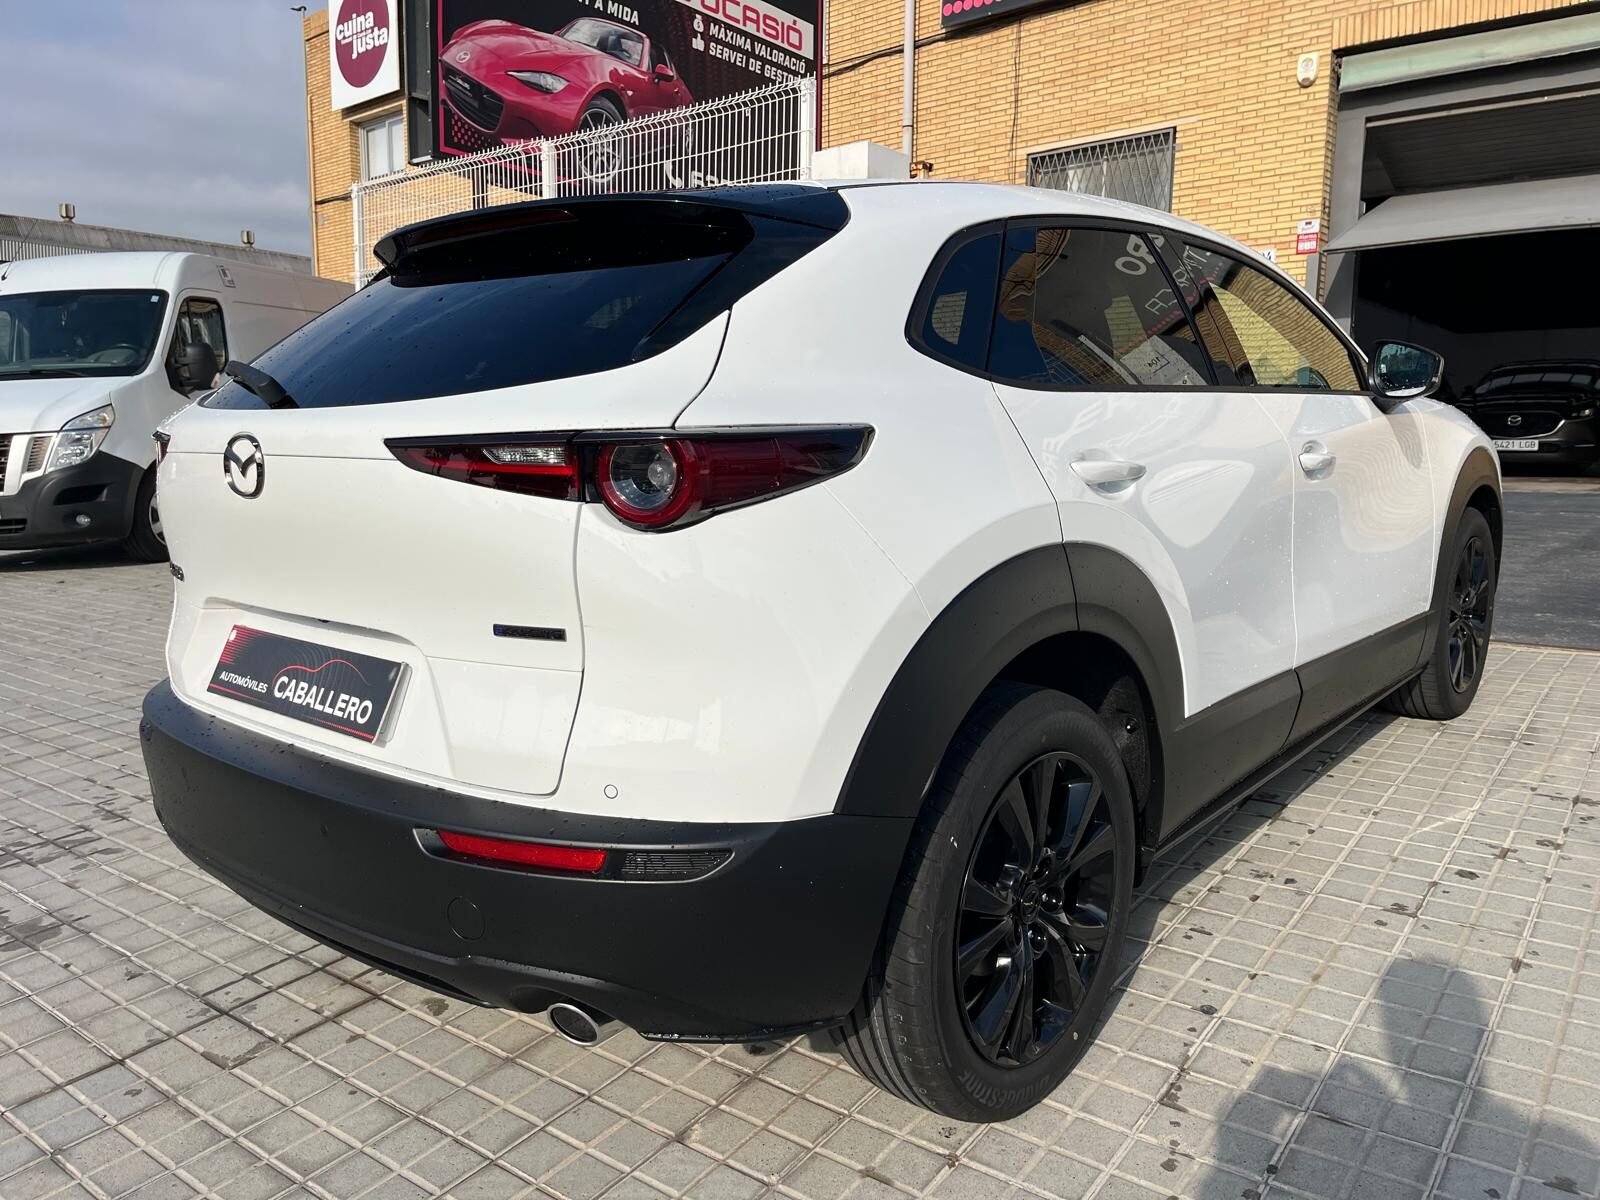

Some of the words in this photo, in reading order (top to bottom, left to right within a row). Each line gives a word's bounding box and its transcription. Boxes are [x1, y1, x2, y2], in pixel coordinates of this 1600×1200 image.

[336, 11, 374, 41] cuina
[607, 0, 640, 26] MIDA
[352, 26, 388, 60] justa
[708, 42, 746, 68] SERVEI
[748, 58, 762, 75] DE
[709, 22, 752, 53] MÀXIMA
[754, 41, 807, 74] VALORACIÓ
[1494, 441, 1515, 449] 5421
[1519, 441, 1537, 449] LGB
[219, 671, 269, 694] AUTOMÓVILES
[273, 676, 373, 725] CABALLERO
